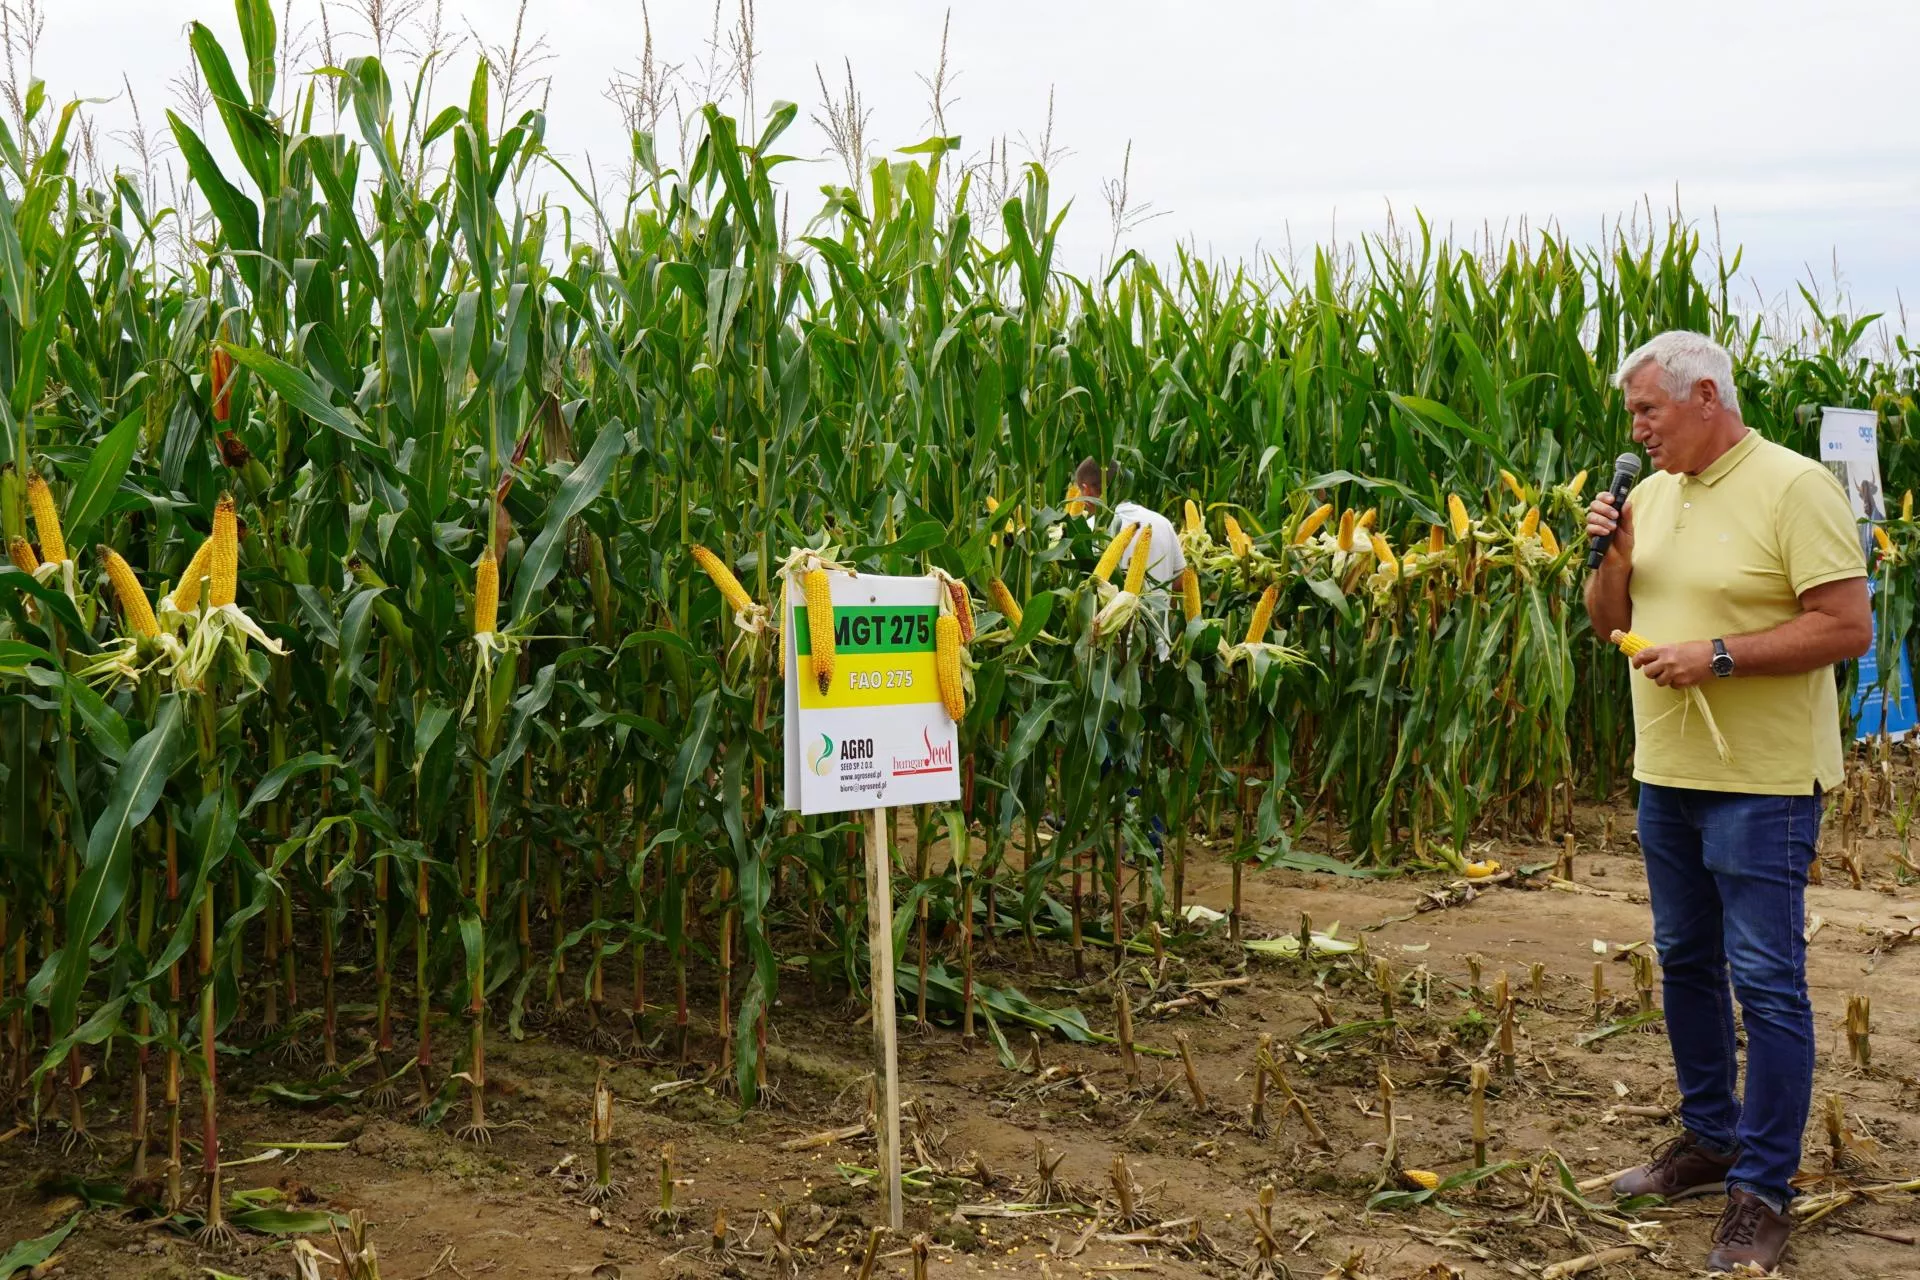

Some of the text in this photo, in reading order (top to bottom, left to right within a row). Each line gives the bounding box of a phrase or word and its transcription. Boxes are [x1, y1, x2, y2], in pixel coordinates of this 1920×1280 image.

[834, 614, 930, 646] MGT 275
[849, 669, 913, 690] FAO 275
[840, 738, 874, 760] AGRO
[840, 763, 853, 771] SEED
[840, 770, 882, 781] www.agroseed.pl
